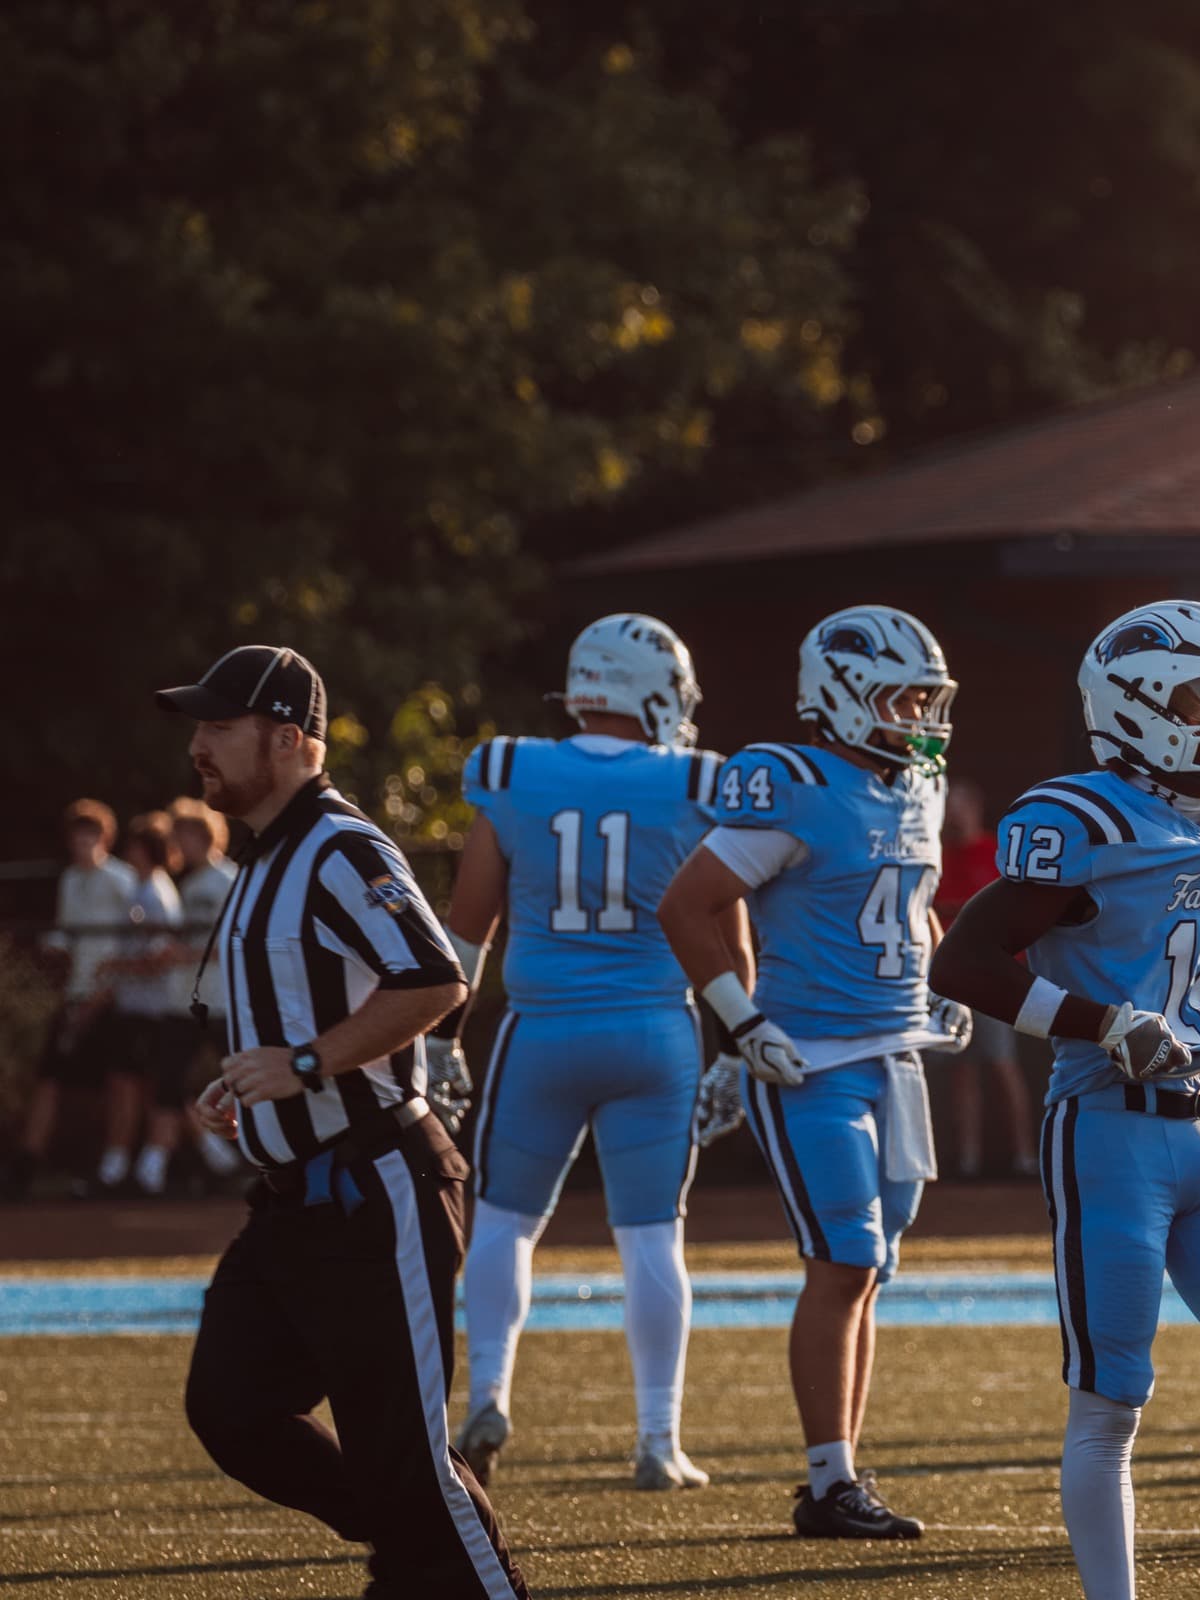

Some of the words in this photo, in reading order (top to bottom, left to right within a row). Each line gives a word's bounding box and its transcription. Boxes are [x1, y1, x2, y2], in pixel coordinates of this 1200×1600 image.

[722, 766, 774, 811] 44
[549, 808, 637, 933] 11
[1006, 823, 1065, 883] 12
